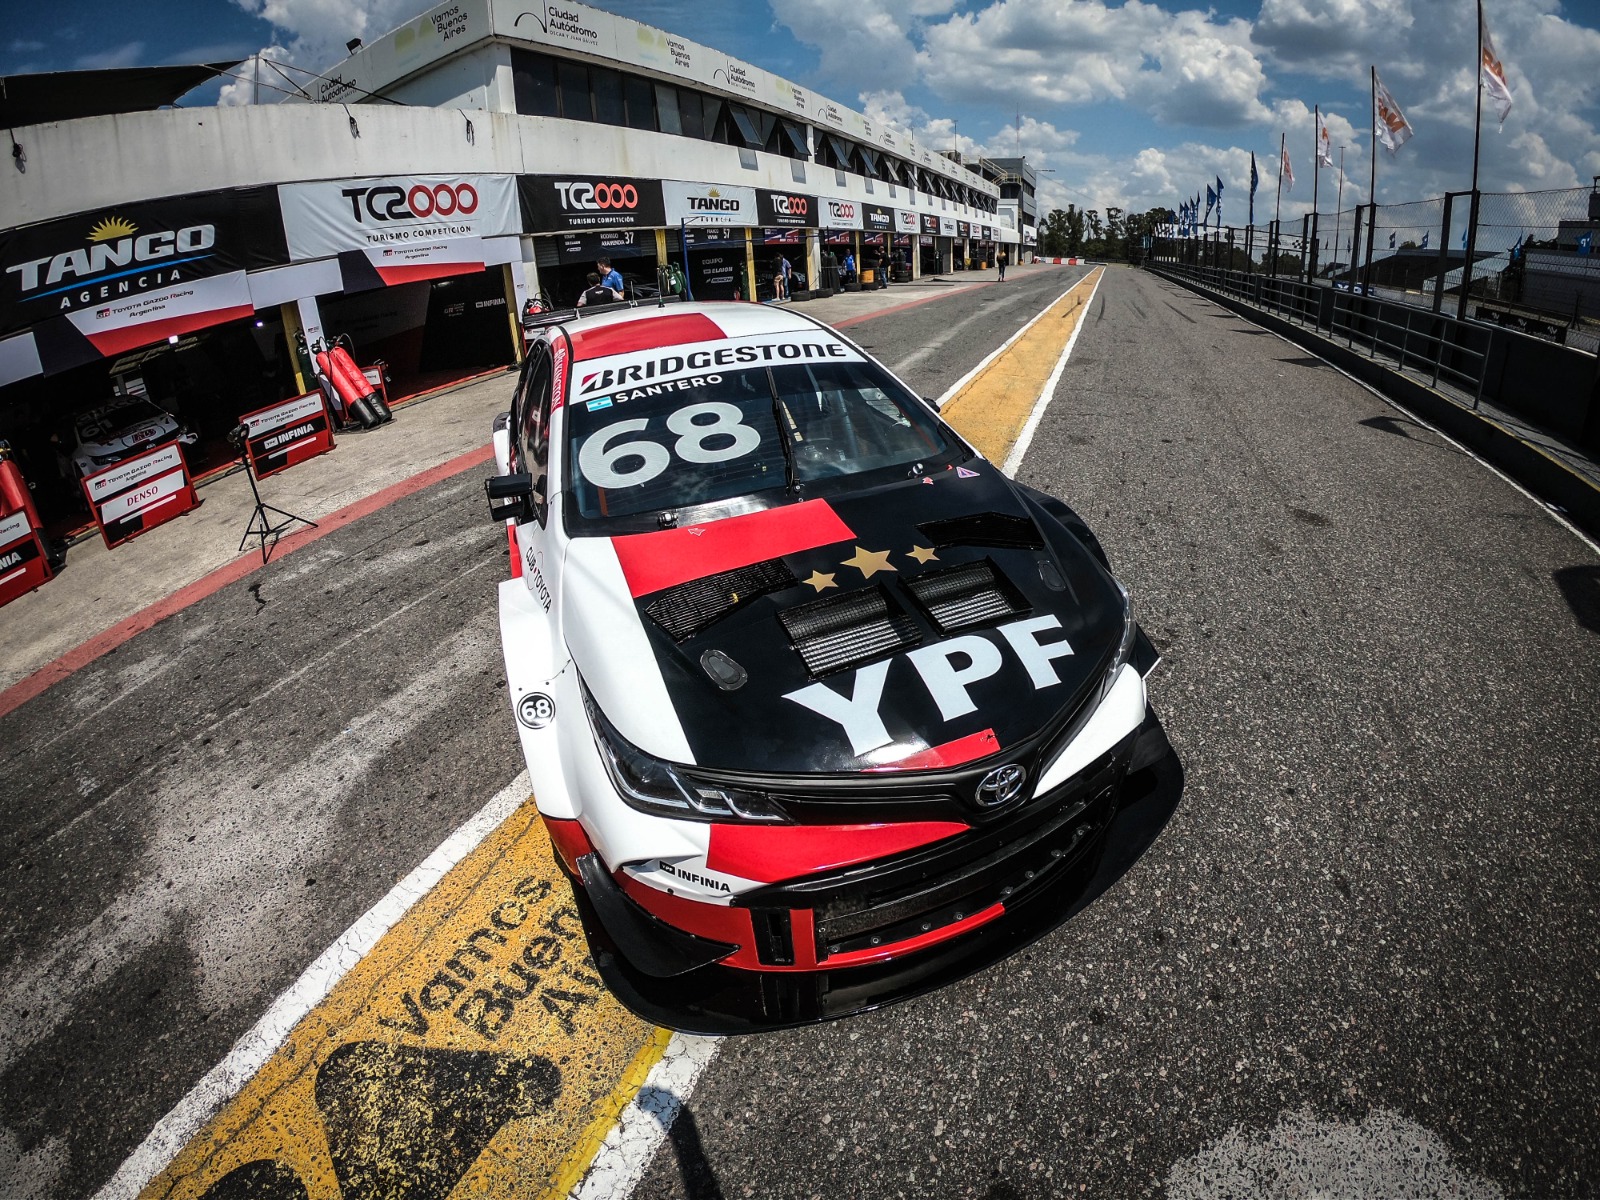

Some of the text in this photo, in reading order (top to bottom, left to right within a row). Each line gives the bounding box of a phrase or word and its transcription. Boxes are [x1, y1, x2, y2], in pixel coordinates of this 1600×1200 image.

[431, 6, 459, 25] Vamos
[437, 12, 468, 33] Buenos
[549, 6, 579, 23] Ciudad
[444, 25, 466, 41] Aires
[550, 18, 598, 39] Autódromo
[666, 38, 685, 51] Vamos
[671, 48, 691, 61] Buenos
[675, 57, 690, 68] Aires
[730, 64, 746, 77] Ciudad
[320, 73, 342, 94] Ciudad
[342, 183, 479, 223] TC2000
[554, 182, 639, 210] TC2000
[687, 197, 740, 212] TANGO
[770, 194, 808, 215] TC2000
[569, 215, 635, 225] TURISMO COMPETICIÓN
[828, 202, 855, 218] TC2000
[870, 213, 890, 223] TANGO
[366, 225, 472, 243] TURISMO COMPETICIÓN
[624, 231, 635, 245] 37
[5, 224, 216, 292] TANGO
[405, 252, 430, 260] Argentina
[432, 244, 448, 252] Racing
[60, 269, 181, 309] AGENCIA
[112, 303, 142, 315] TOYOTA
[170, 289, 194, 300] Racing
[129, 304, 166, 318] Argentina
[483, 298, 506, 308] INFINIA
[580, 342, 848, 396] BRIDGESTONE
[615, 374, 724, 404] SANTERO
[261, 414, 280, 424] TOYOTA
[278, 423, 315, 444] INFINIA
[578, 402, 761, 489] 68
[108, 471, 131, 484] TOYOTA
[153, 454, 173, 465] Racing
[126, 470, 147, 482] Argentina
[127, 486, 158, 507] DENSO
[525, 546, 552, 614] CLUB TOYOTA
[781, 614, 1075, 758] YPF
[522, 698, 551, 721] 68
[677, 868, 731, 893] INFINIA
[377, 875, 552, 1036] Vamos
